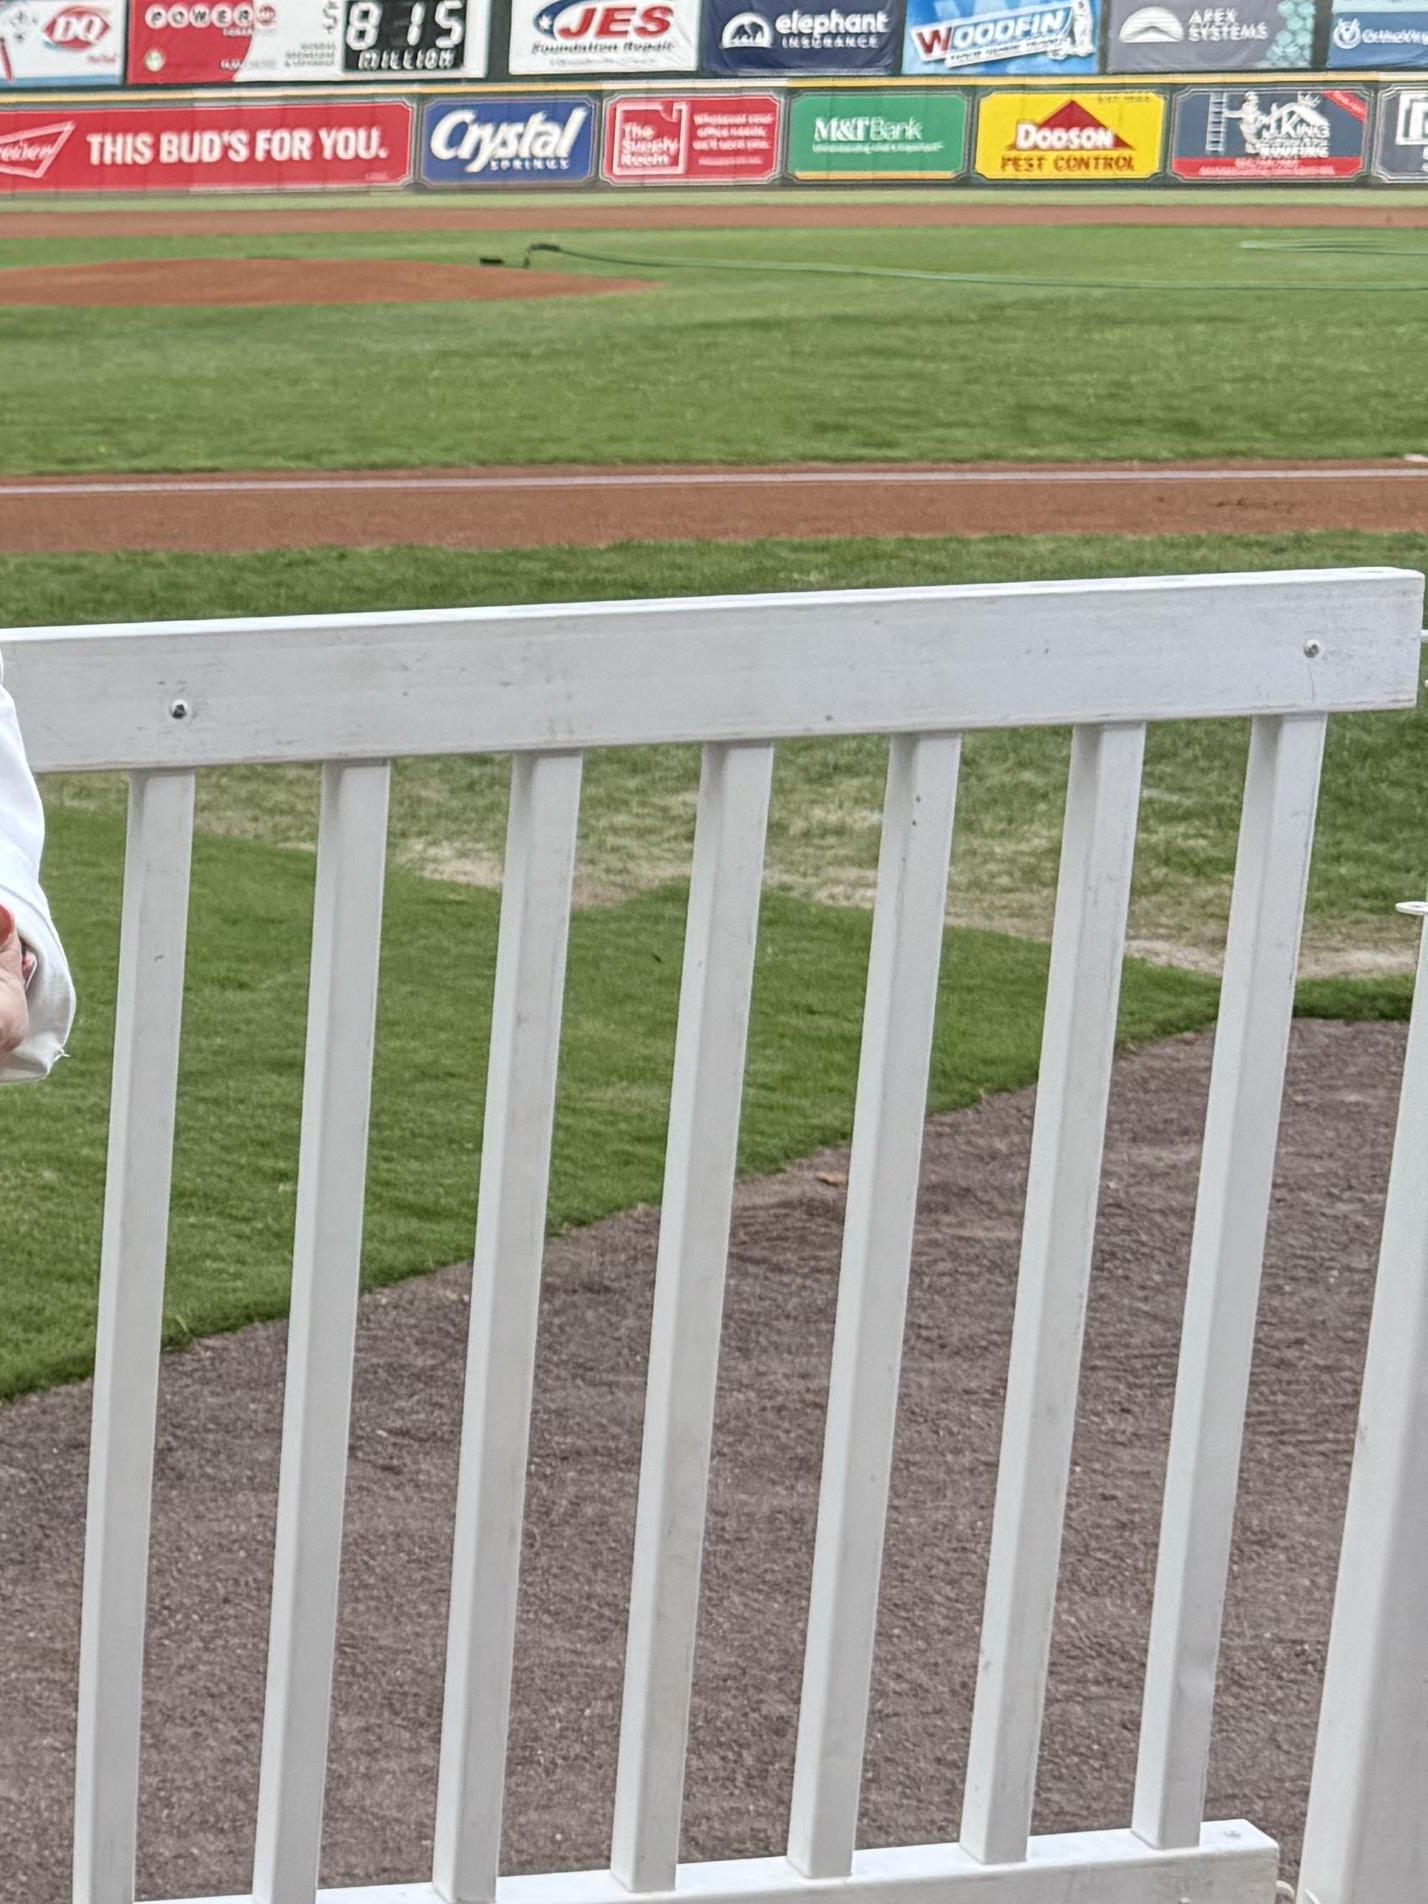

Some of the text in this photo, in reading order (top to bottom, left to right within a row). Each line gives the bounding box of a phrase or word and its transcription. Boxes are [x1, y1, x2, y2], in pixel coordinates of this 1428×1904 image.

[322, 0, 466, 50] $ 815
[558, 6, 674, 39] JES
[775, 8, 890, 42] elephant
[1188, 8, 1239, 23] APEX
[52, 14, 102, 45] DQ
[916, 9, 1066, 56] WOODFIN
[1188, 22, 1269, 41] SYSTEMS
[531, 40, 674, 55] Foundation Repair
[782, 37, 879, 49] INSURANCE
[357, 47, 456, 70] MILLION
[430, 106, 592, 173] Crystal
[624, 122, 654, 139] The
[814, 115, 922, 142] M&T Bank
[1016, 121, 1114, 150] DODSON
[87, 126, 388, 165] THIS BUD'S FOR YOU.
[623, 137, 678, 156] Supply
[489, 160, 570, 171] SPRINGS
[621, 154, 669, 166] Room
[1000, 155, 1135, 172] PEST CONTROL
